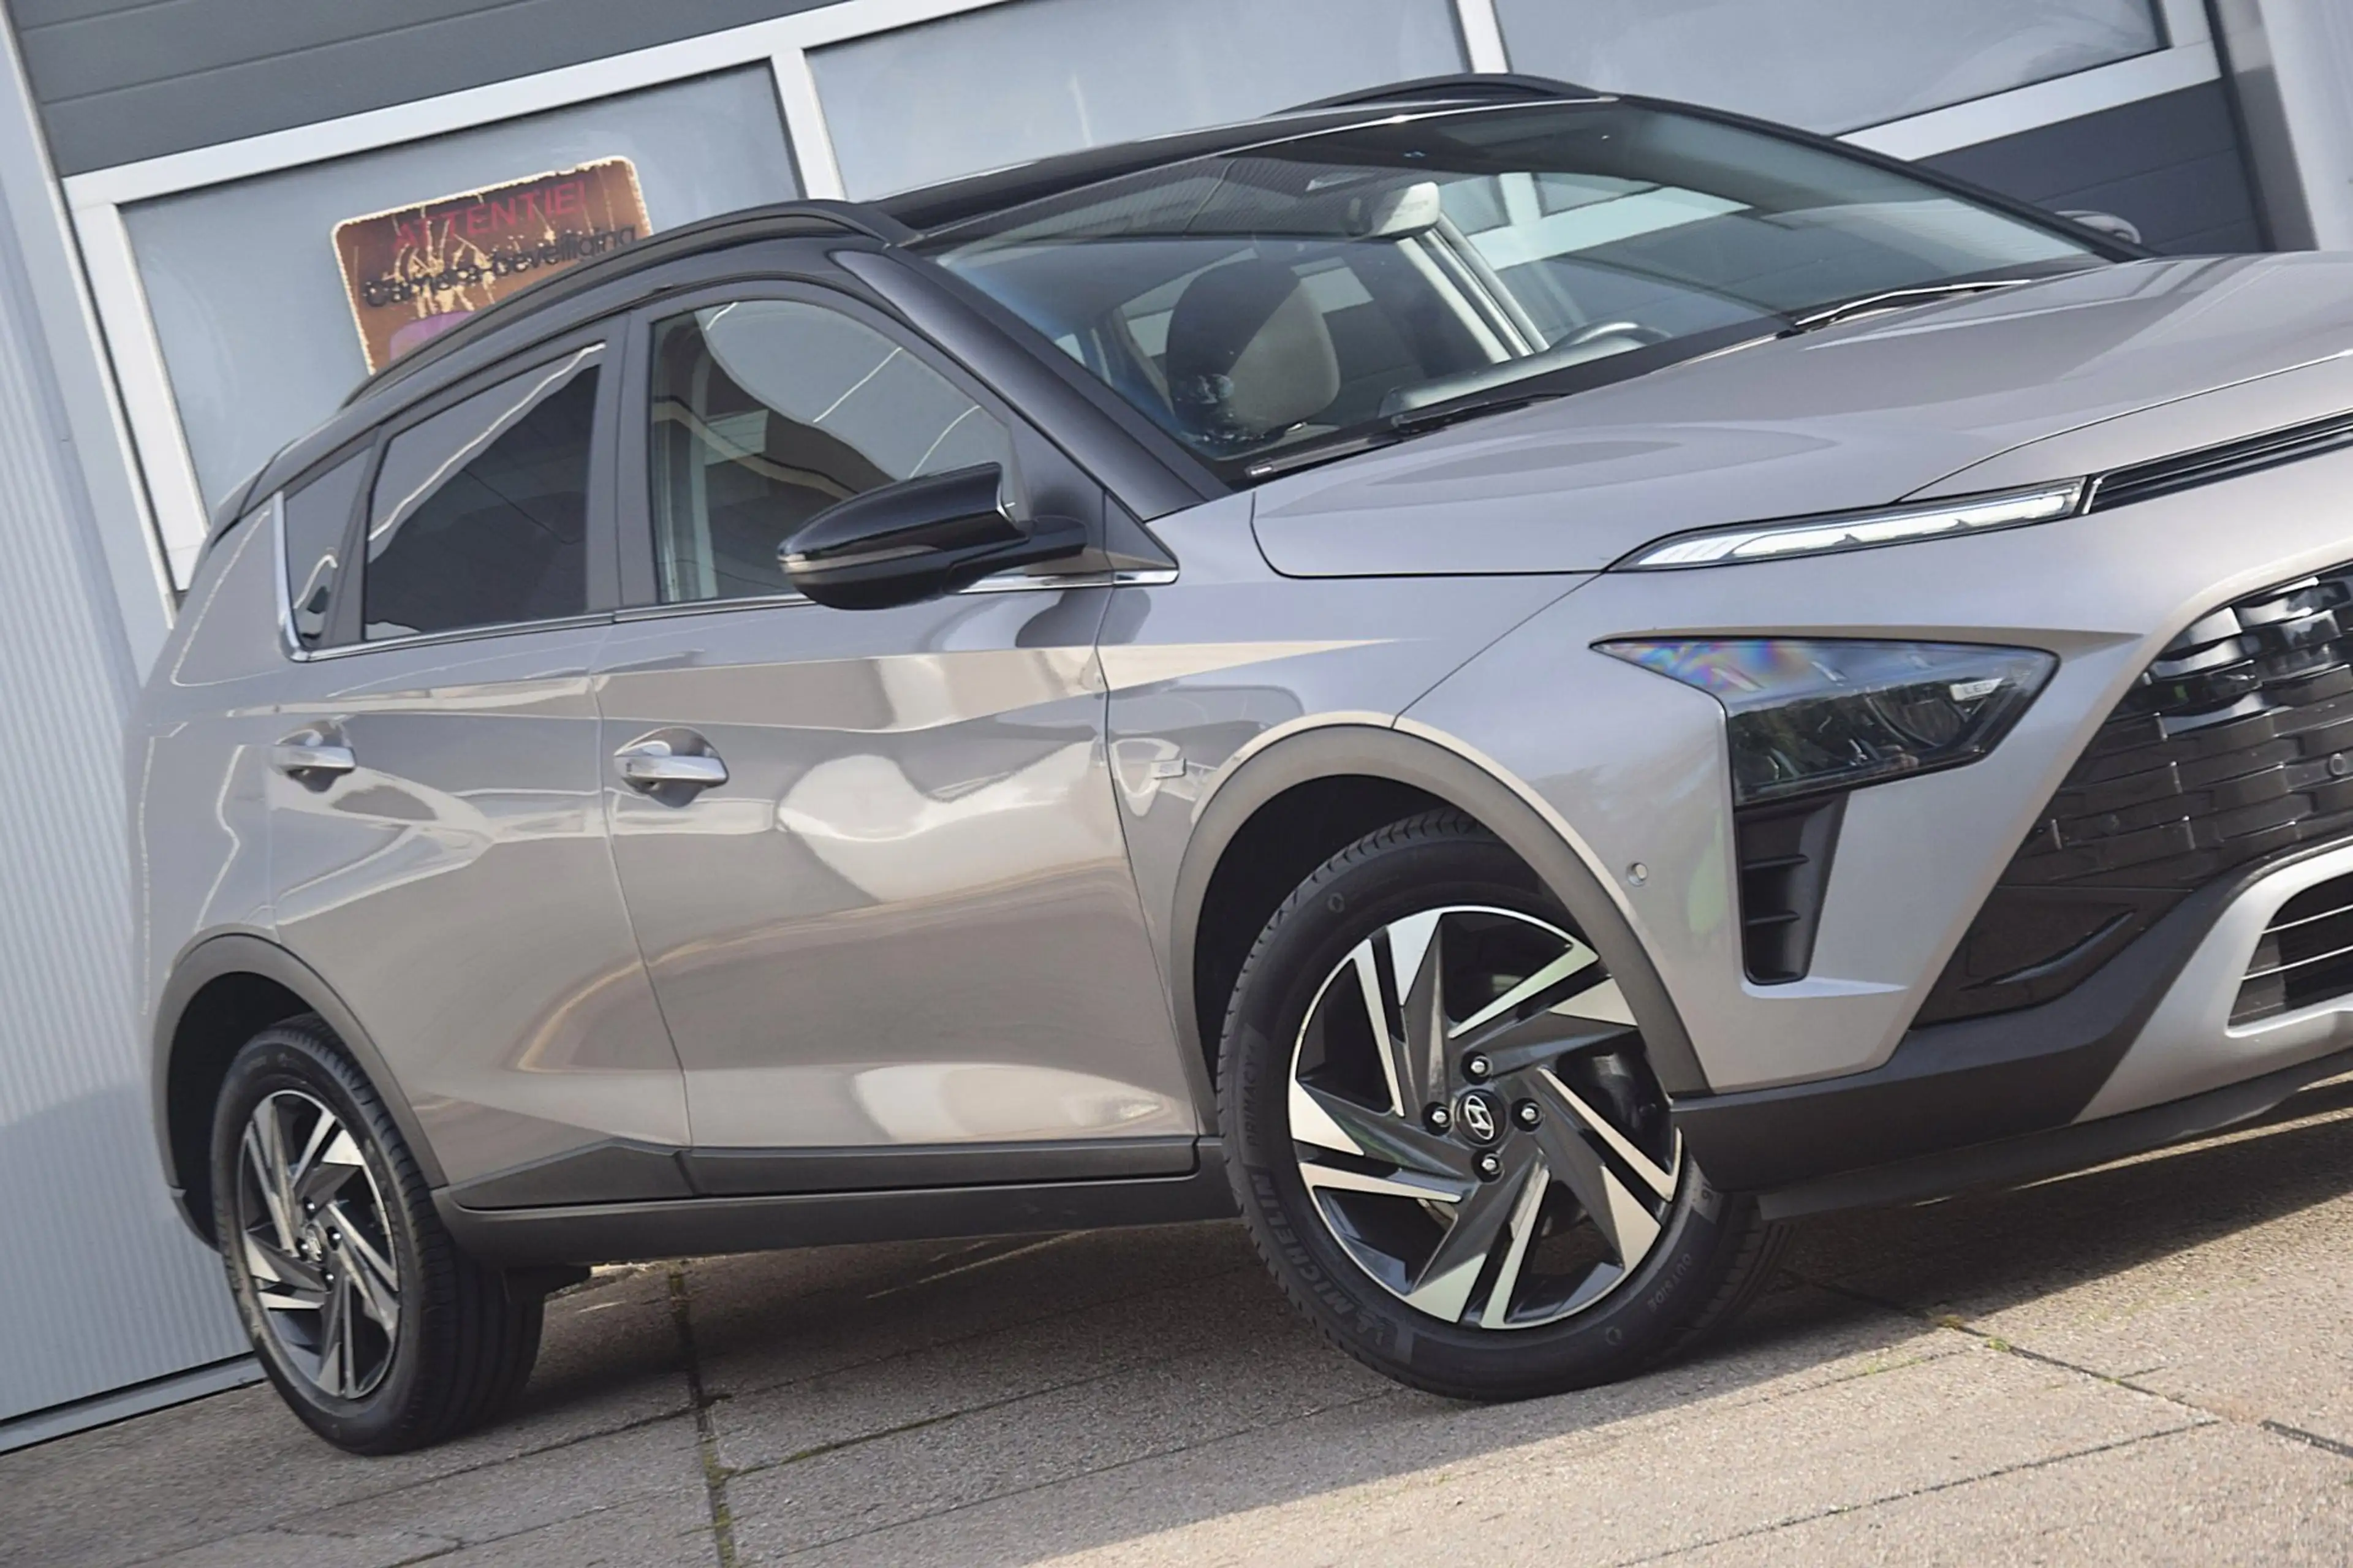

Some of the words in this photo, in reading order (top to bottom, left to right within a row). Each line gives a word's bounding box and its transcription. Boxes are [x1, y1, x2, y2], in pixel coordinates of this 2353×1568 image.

[393, 180, 586, 249] ATTENTIE!
[1962, 683, 1992, 694] LED
[1243, 1059, 1260, 1147] PRIMACY
[1250, 1173, 1355, 1315] MICHELIN
